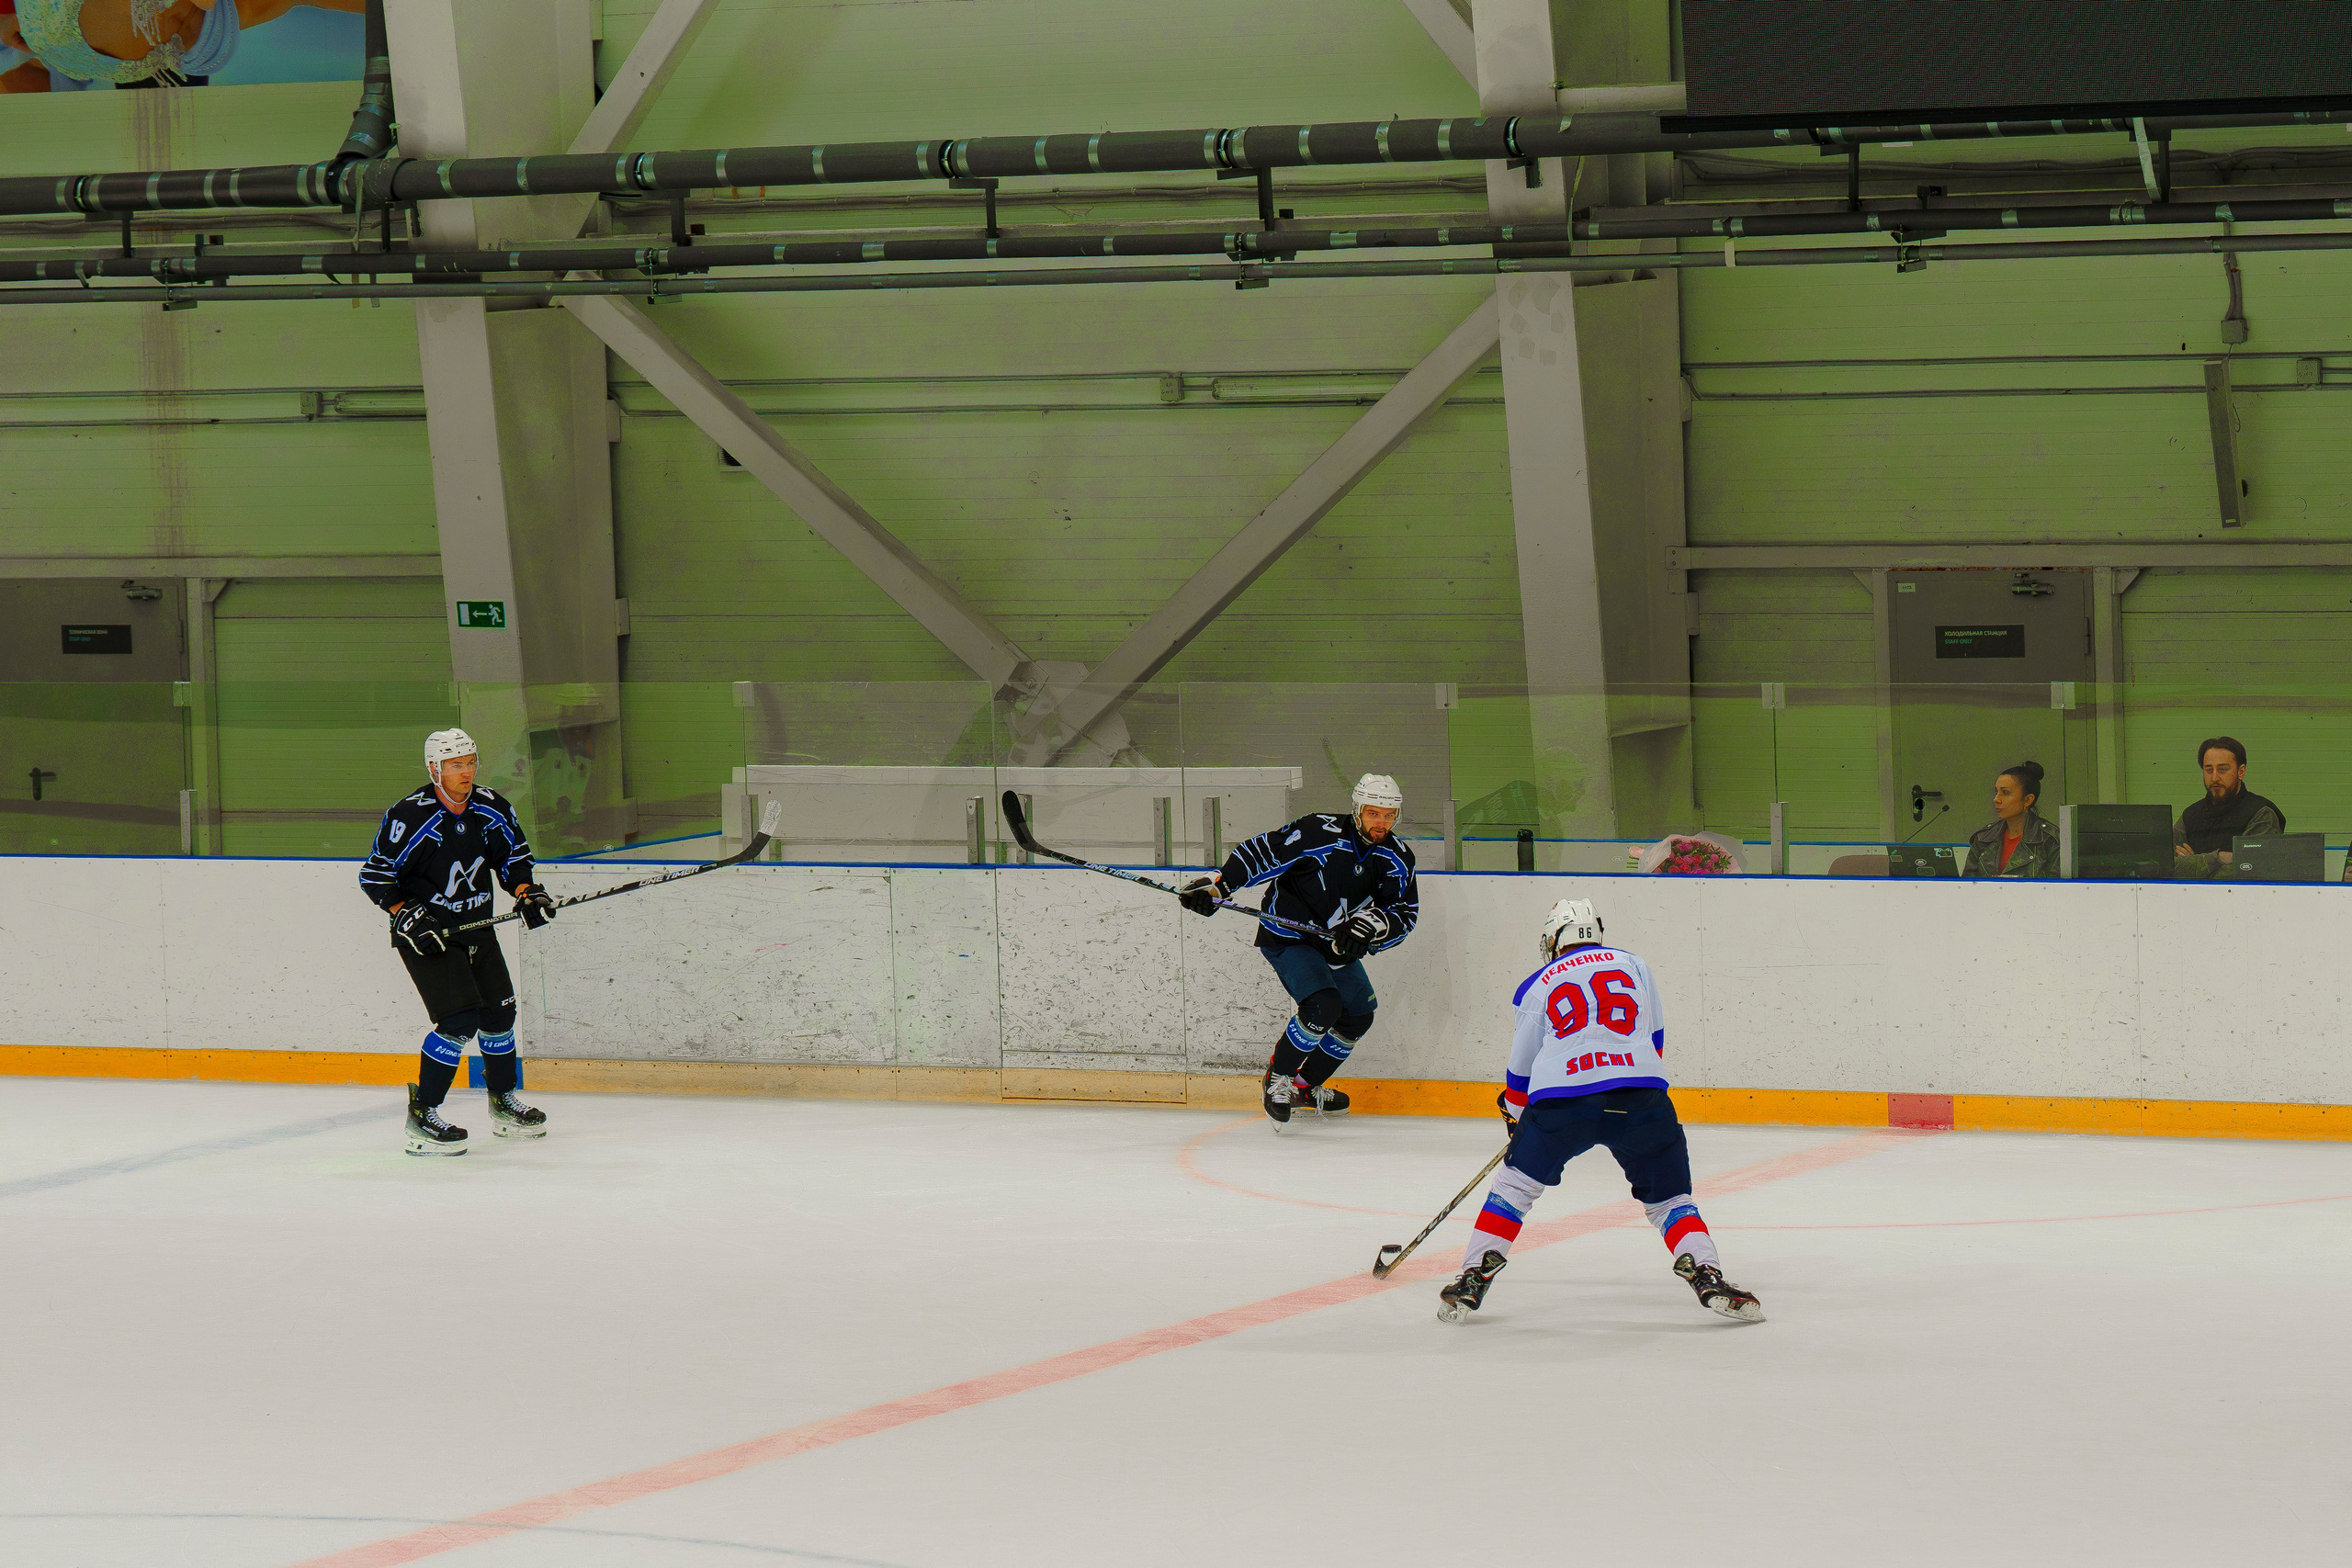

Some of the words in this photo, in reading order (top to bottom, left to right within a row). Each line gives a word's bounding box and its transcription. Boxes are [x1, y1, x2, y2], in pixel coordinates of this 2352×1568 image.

[459, 911, 518, 931] DOMINATOR
[1261, 910, 1299, 926] DOMINATOR
[1578, 926, 1592, 939] 86
[1541, 952, 1615, 986] ПЕДЧЕНКО
[1566, 1051, 1634, 1076] SOCHI
